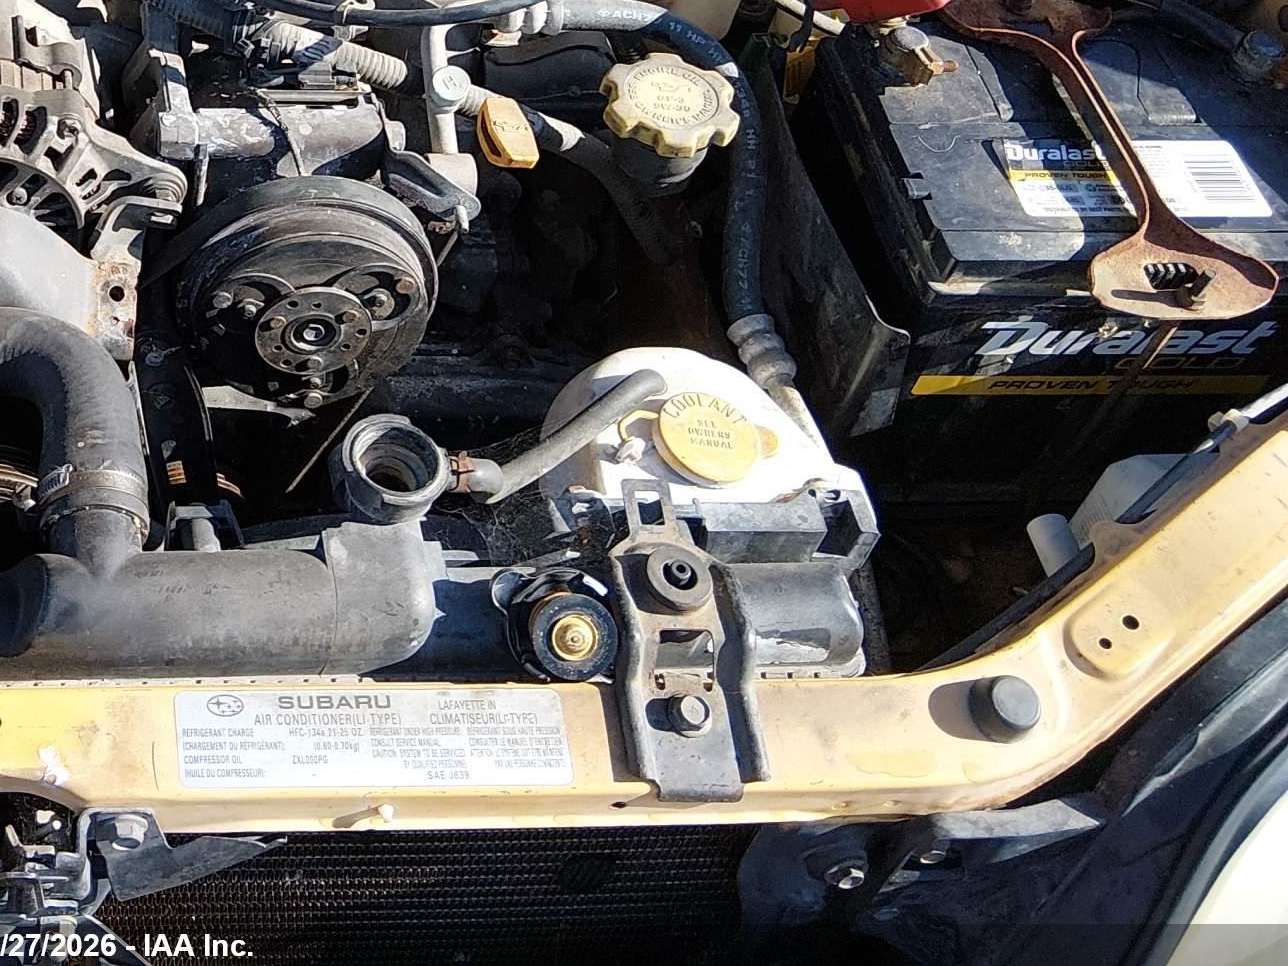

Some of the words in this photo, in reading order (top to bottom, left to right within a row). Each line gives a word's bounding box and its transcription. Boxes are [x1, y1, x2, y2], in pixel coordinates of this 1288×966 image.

[987, 380, 1097, 390] PROVEN
[662, 392, 748, 425] COOLANT
[278, 695, 392, 710] SUBARU
[438, 699, 486, 710] LAFAYETTE
[254, 714, 273, 726] AIR
[181, 728, 226, 737] REFRIGERANT
[227, 728, 255, 737] CHARGE
[184, 755, 231, 764] COMPRESSOR
[427, 771, 446, 780] SAE
